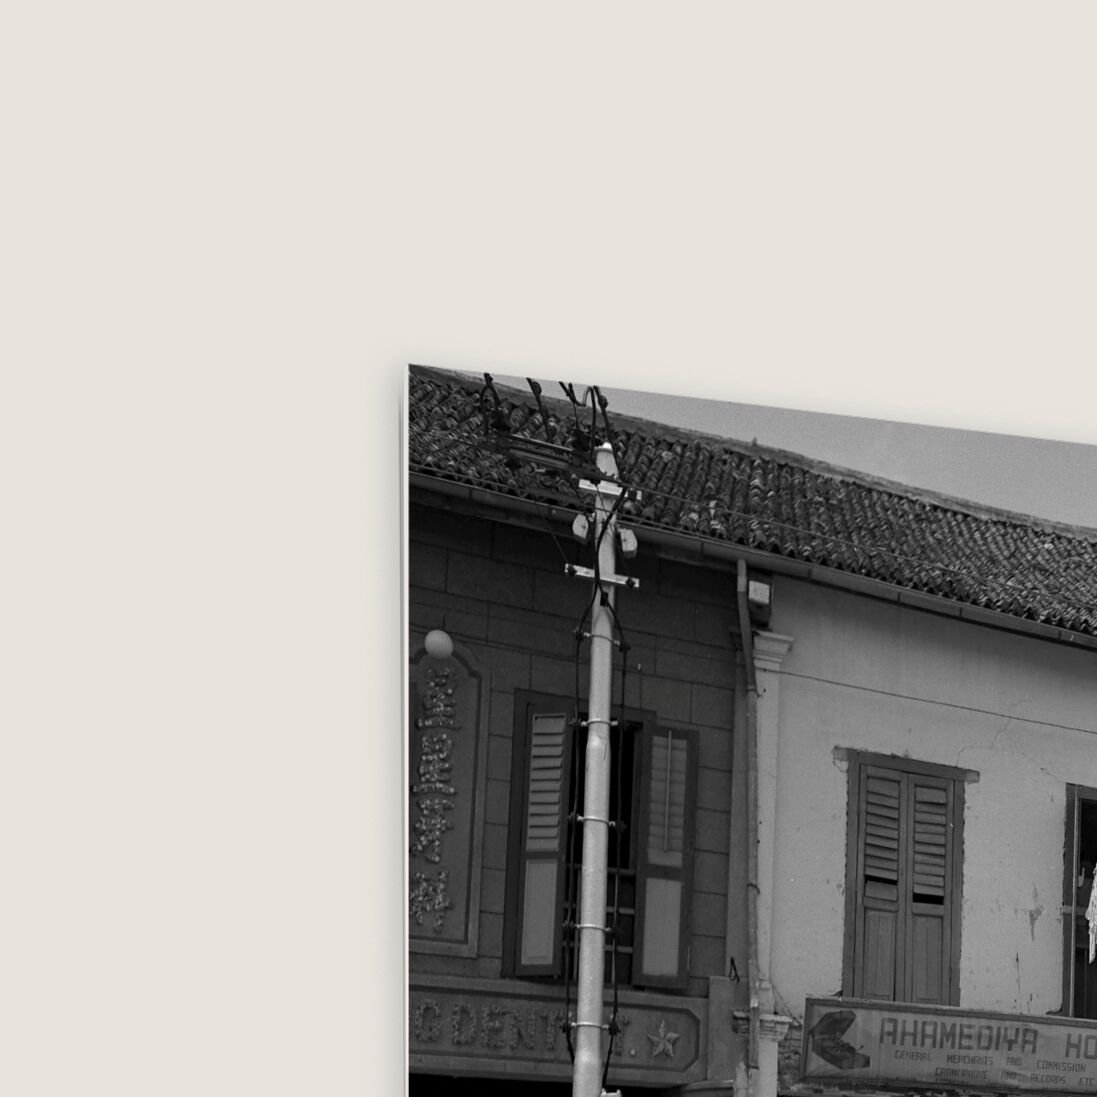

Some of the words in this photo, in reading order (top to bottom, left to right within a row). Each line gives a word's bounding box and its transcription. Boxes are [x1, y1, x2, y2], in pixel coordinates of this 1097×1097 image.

[880, 1018, 1039, 1054] AHAMEDIYA
[895, 1049, 932, 1061] GENERAL
[946, 1054, 994, 1066] MERCHANTS
[1006, 1056, 1022, 1067] AND
[1036, 1060, 1087, 1073] COMMISSION
[935, 1066, 990, 1081] GRAMOPHONE
[1030, 1072, 1067, 1086] RECORDS
